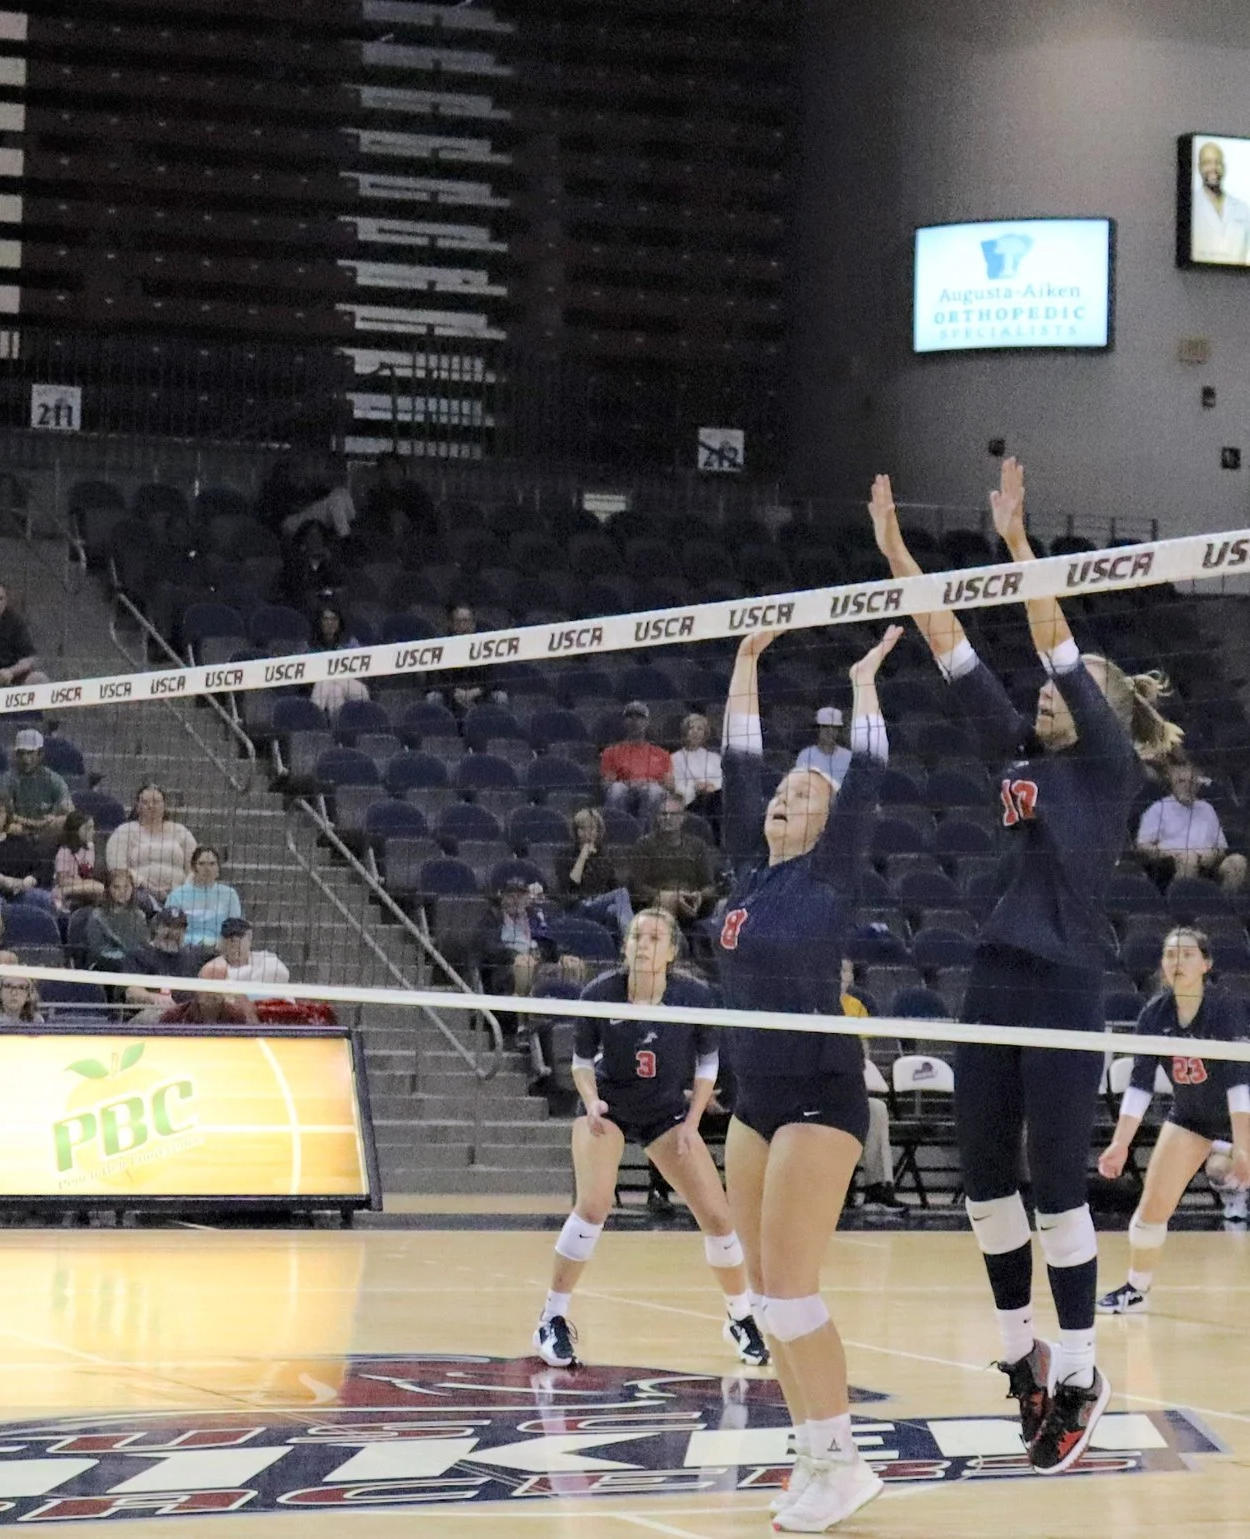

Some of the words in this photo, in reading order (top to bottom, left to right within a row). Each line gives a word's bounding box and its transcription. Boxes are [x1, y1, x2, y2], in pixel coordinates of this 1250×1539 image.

[939, 283, 1081, 305] Augusta-Aiken
[934, 306, 1086, 325] ORTHOPEDIC
[939, 324, 1079, 341] SPECIALISTS
[1202, 538, 1250, 569] US
[635, 1050, 657, 1078] 3
[53, 1080, 195, 1173] PBC
